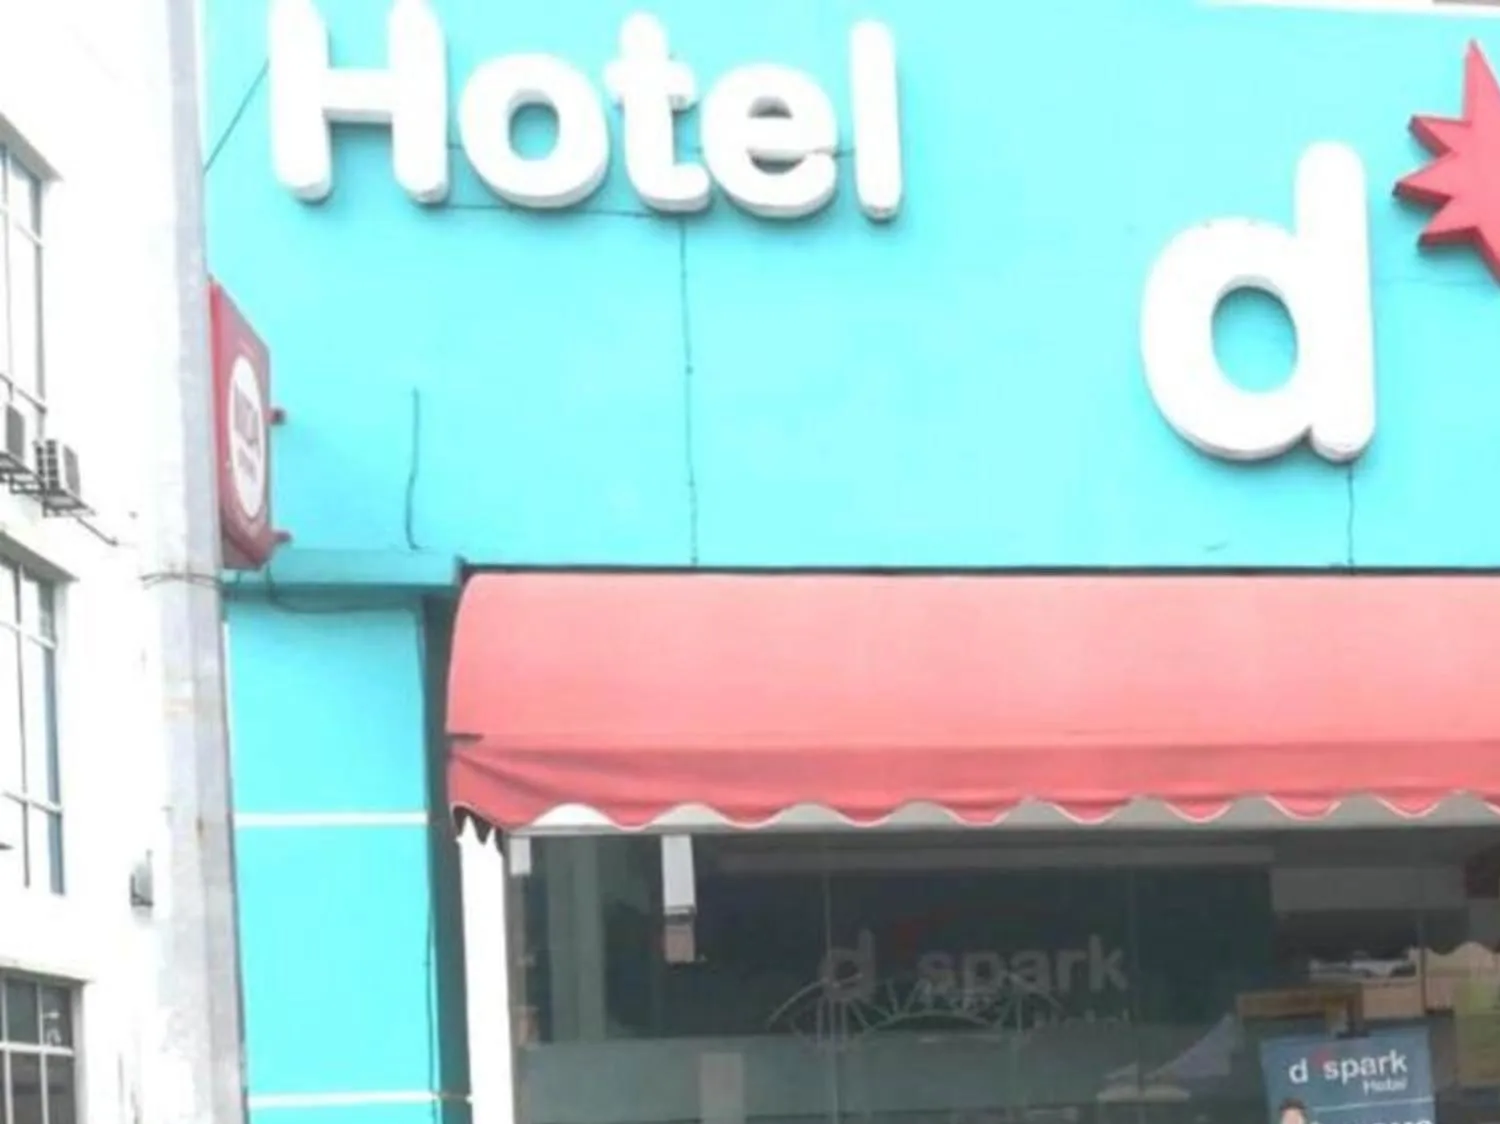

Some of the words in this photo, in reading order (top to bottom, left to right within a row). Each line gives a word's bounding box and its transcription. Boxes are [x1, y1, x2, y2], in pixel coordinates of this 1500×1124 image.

[267, 0, 903, 218] Hotel
[1322, 1049, 1408, 1086] spark
[1362, 1076, 1408, 1096] Hotel
